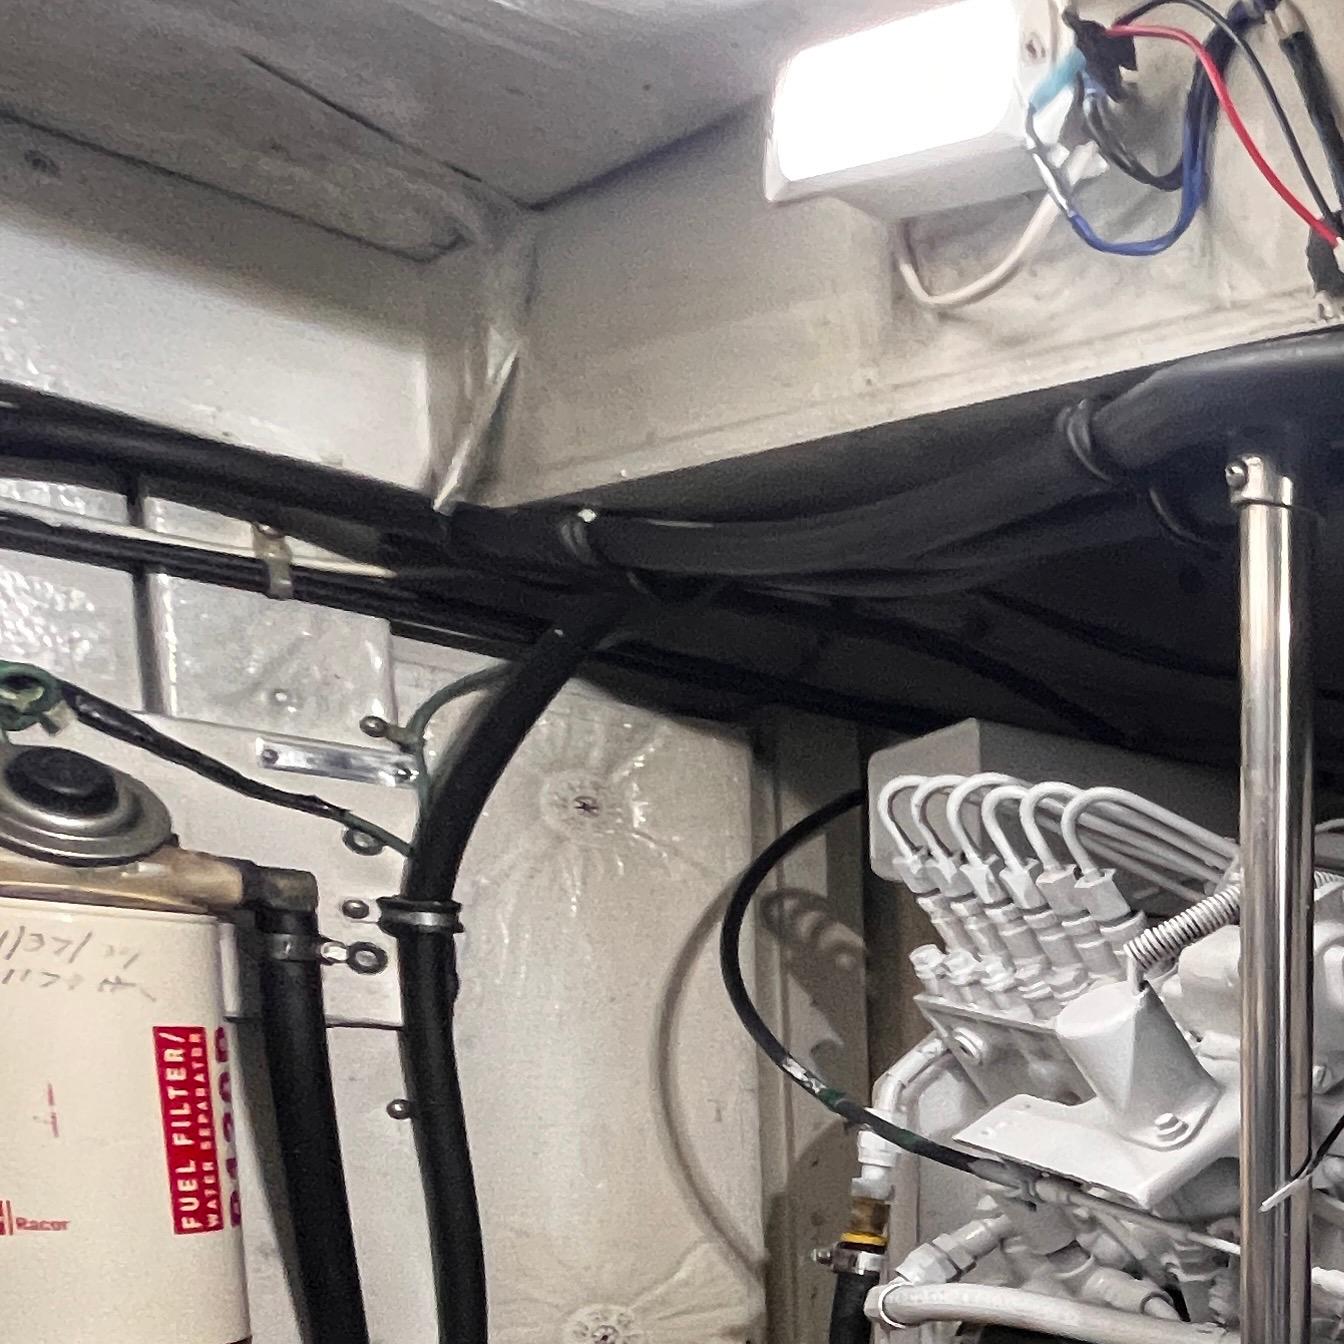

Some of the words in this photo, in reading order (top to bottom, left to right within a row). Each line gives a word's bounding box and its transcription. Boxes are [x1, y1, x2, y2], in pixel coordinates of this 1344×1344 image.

[158, 1031, 195, 1146] FILTER/
[188, 1033, 213, 1150] SEPARATOR
[16, 1216, 71, 1231] Racor
[175, 1160, 203, 1229] FUEL
[202, 1161, 221, 1228] WATER
